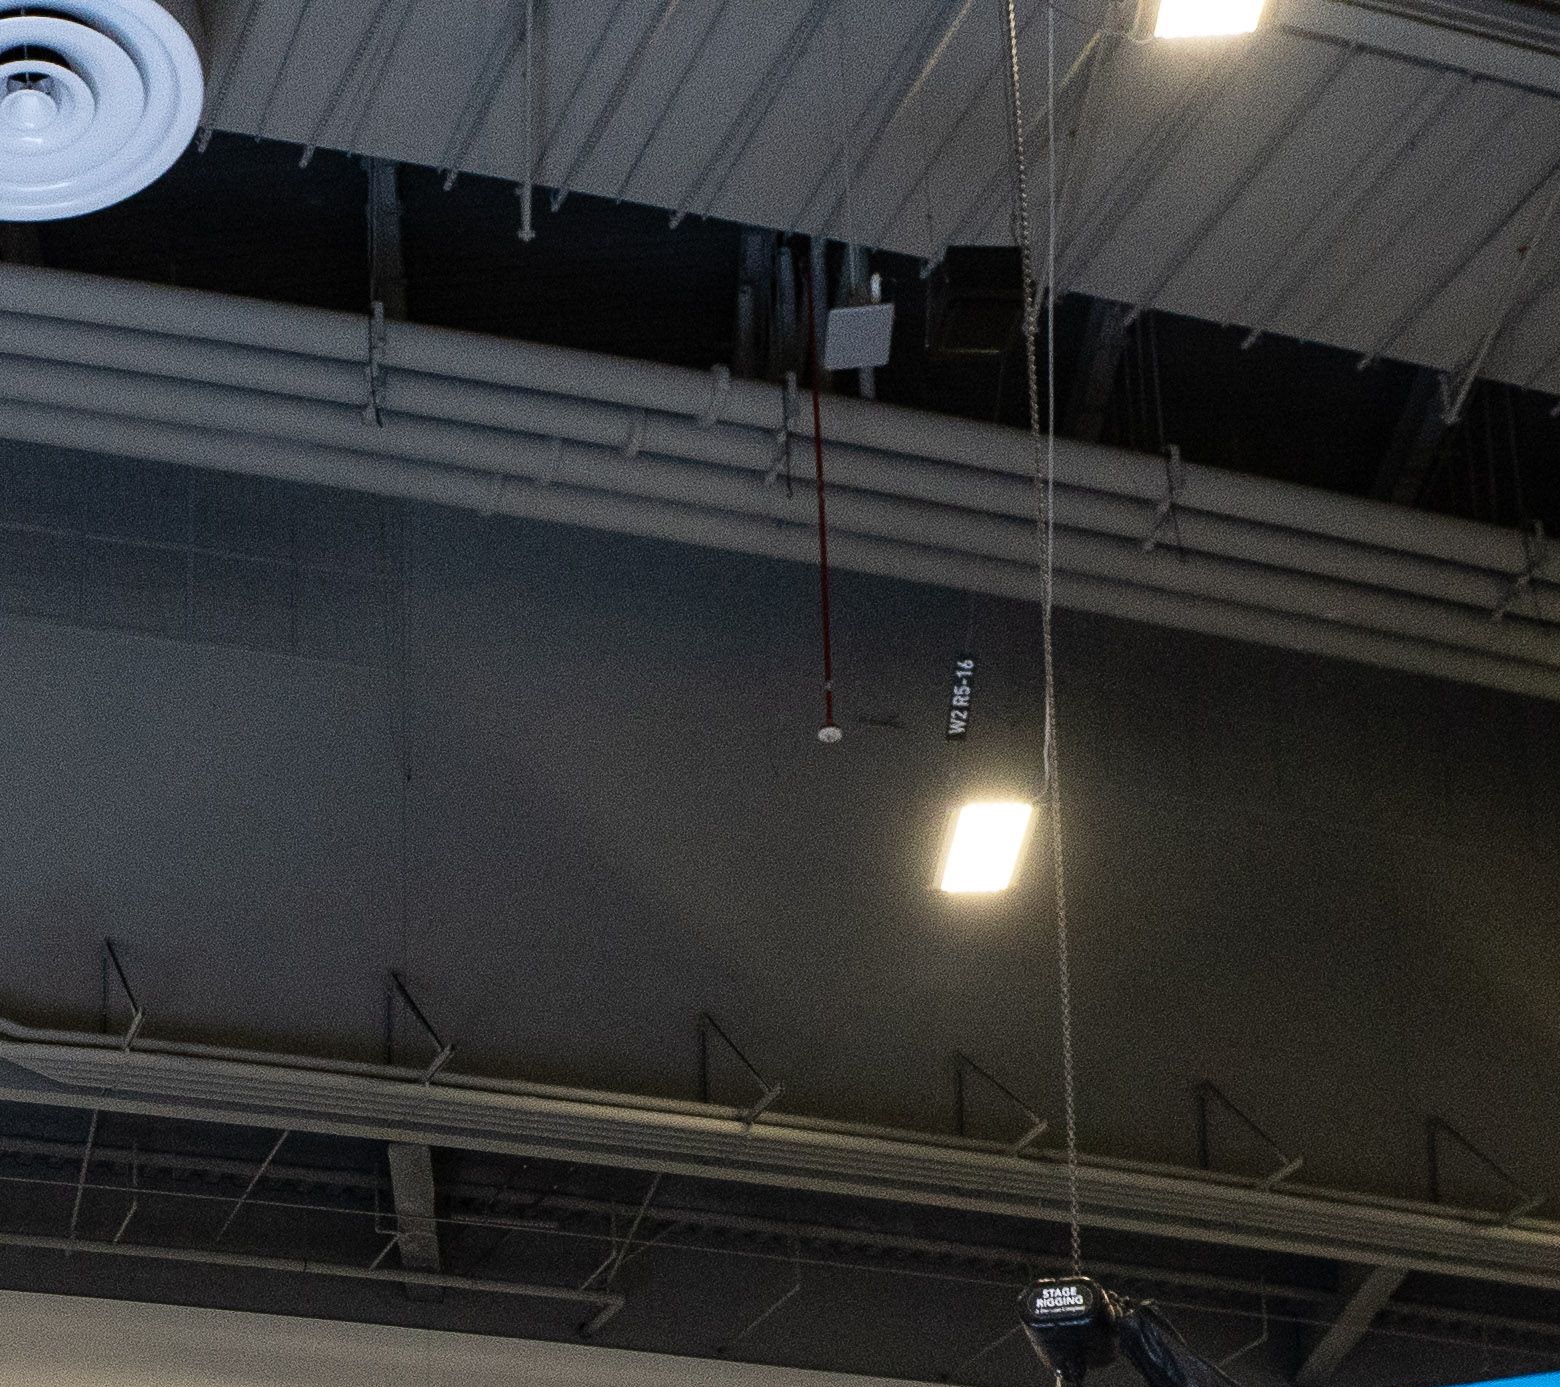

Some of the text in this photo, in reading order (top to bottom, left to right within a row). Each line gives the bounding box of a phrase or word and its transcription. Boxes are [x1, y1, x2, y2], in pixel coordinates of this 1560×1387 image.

[948, 659, 974, 735] W2 R5-16
[1042, 1286, 1077, 1298] STAGE
[1036, 1295, 1083, 1308] RIGGING
